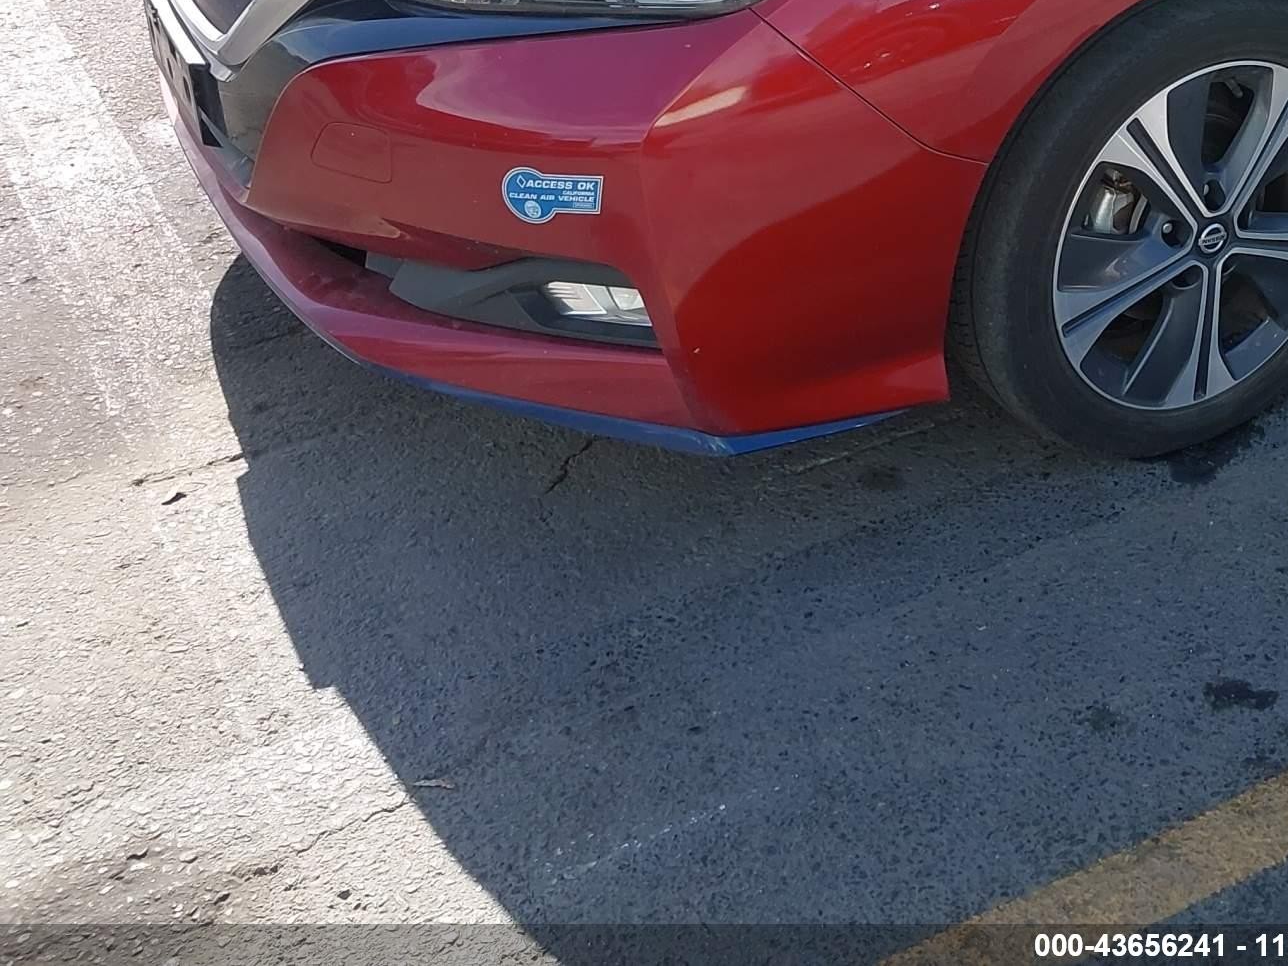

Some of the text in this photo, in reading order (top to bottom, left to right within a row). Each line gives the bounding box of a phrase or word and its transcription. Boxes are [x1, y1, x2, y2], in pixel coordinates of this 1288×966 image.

[526, 179, 595, 190] ACCESS OK
[509, 192, 537, 200] CLEAN
